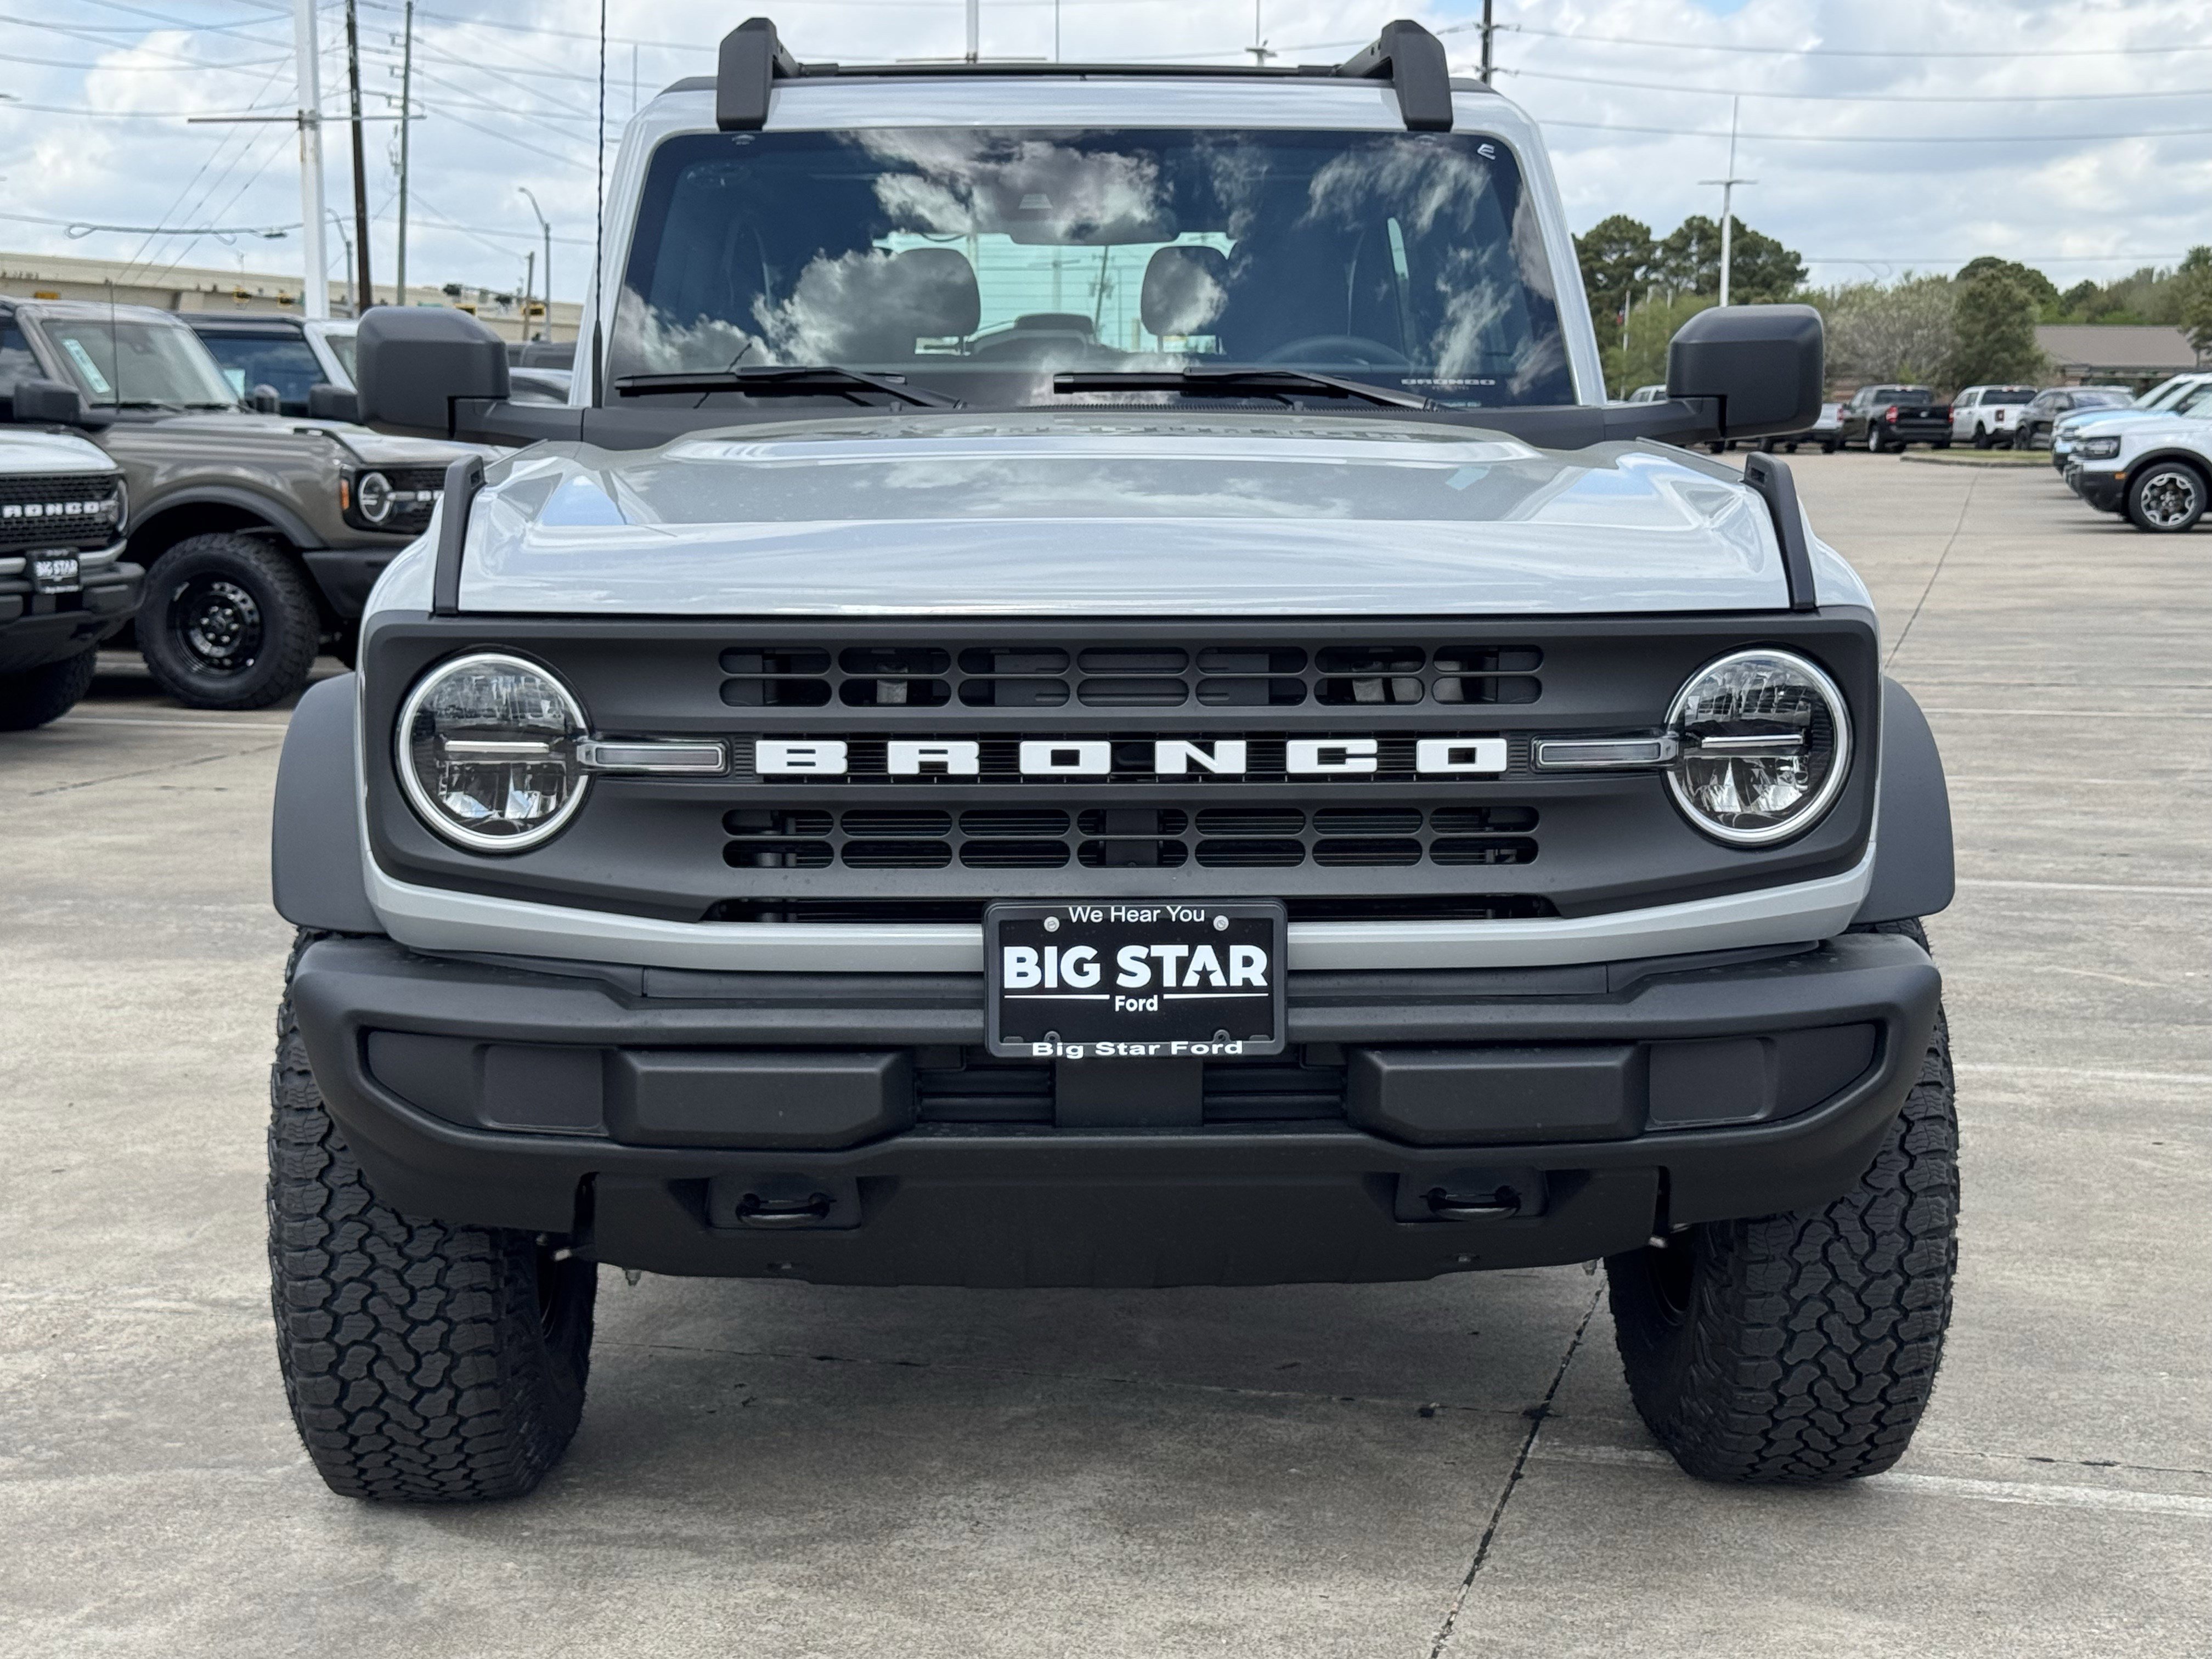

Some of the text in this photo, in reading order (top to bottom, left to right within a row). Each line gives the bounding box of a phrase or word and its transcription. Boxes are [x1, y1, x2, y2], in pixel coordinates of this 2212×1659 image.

[0, 501, 99, 519] RONCO
[755, 738, 1508, 775] BRONCO
[1069, 905, 1205, 923] We Hear You
[1003, 944, 1268, 989] BIG STAR
[1115, 995, 1158, 1012] Ford
[1032, 1041, 1243, 1059] Big Star Ford
